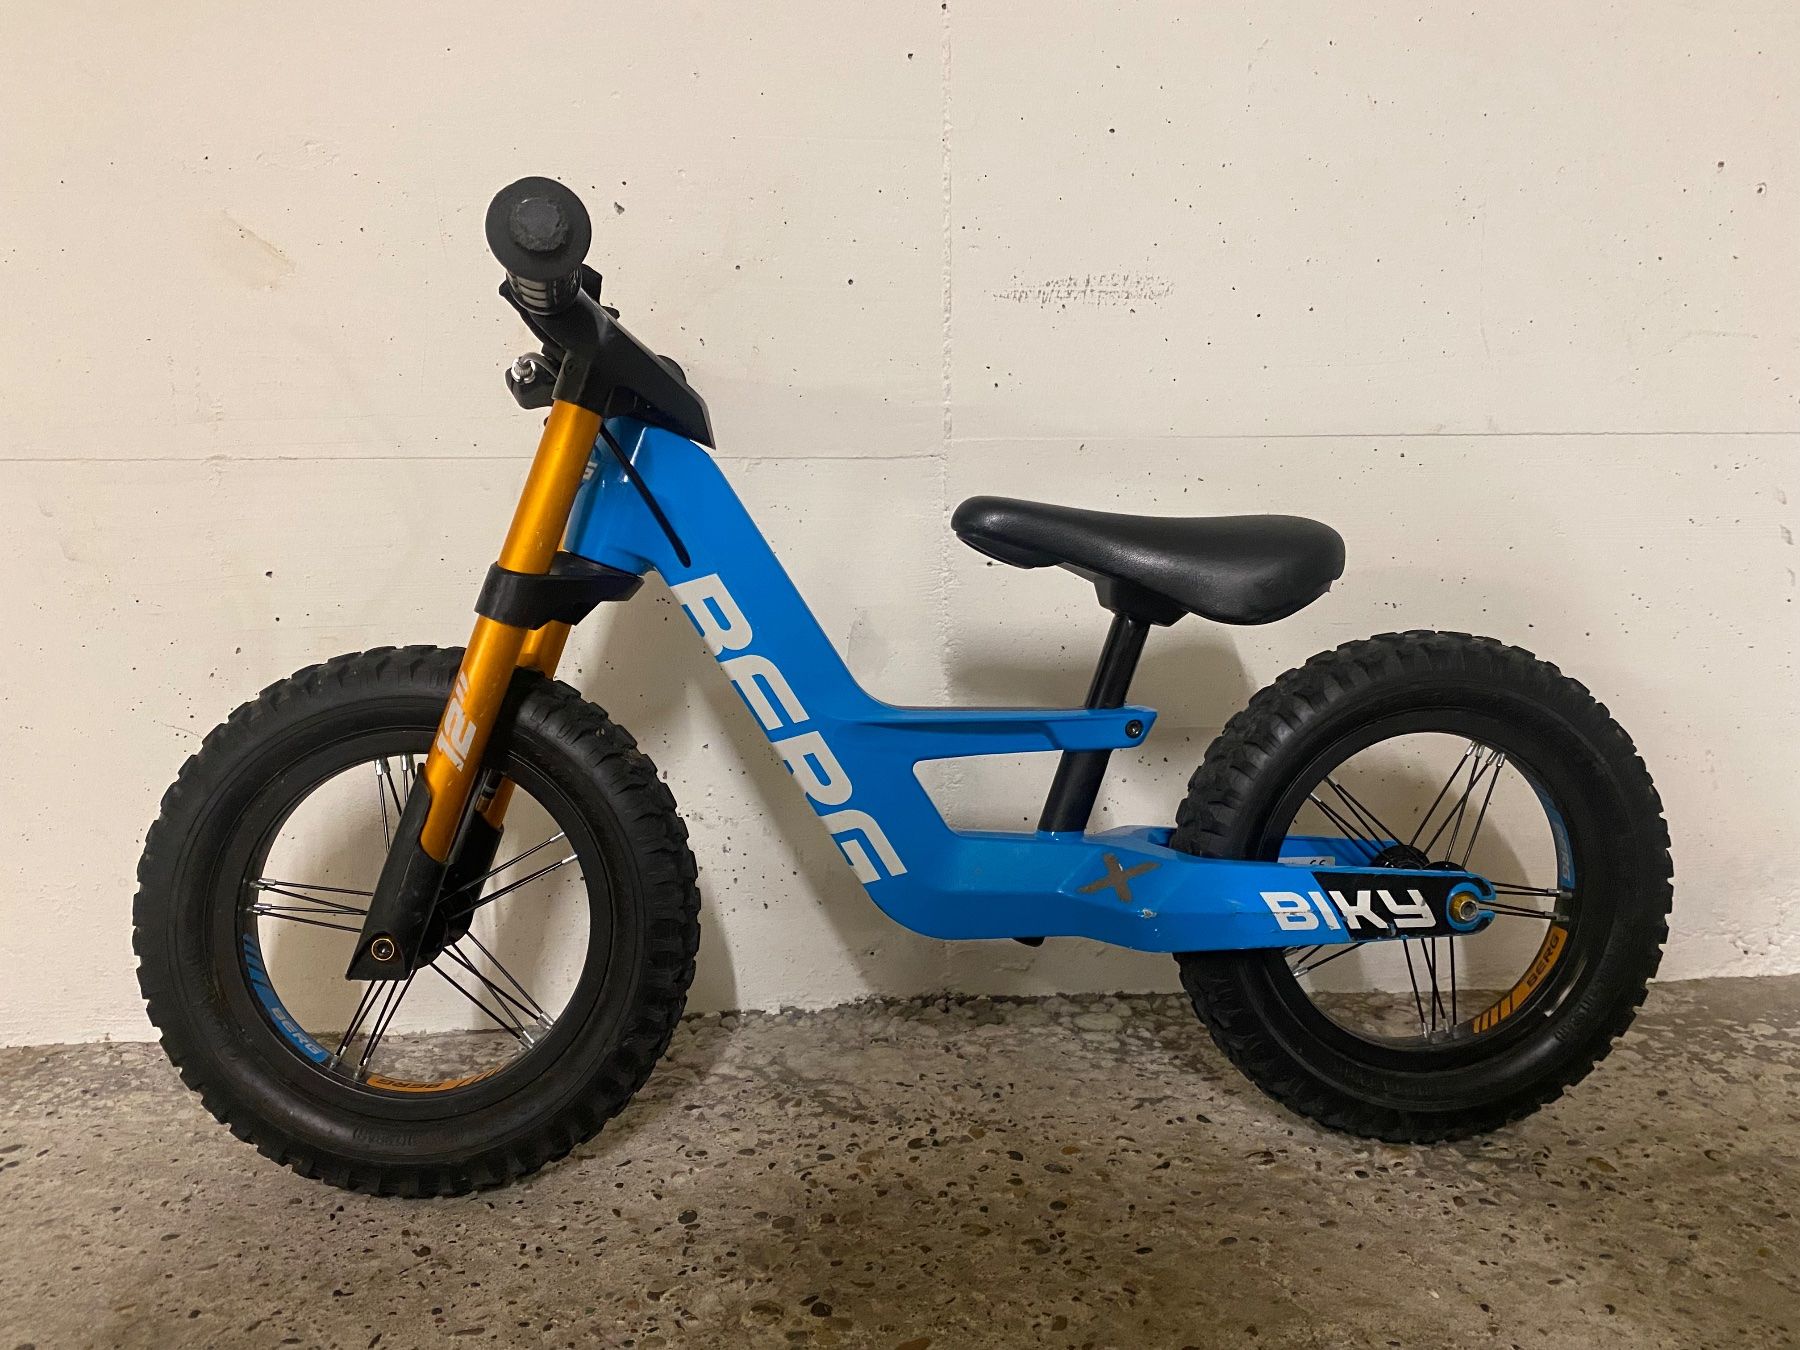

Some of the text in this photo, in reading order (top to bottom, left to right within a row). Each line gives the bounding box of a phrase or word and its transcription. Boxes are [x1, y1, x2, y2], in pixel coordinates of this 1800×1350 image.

[670, 573, 908, 884] BERG
[1259, 889, 1436, 931] BIKY
[1526, 934, 1560, 988] BERG
[270, 1007, 323, 1055] BERG
